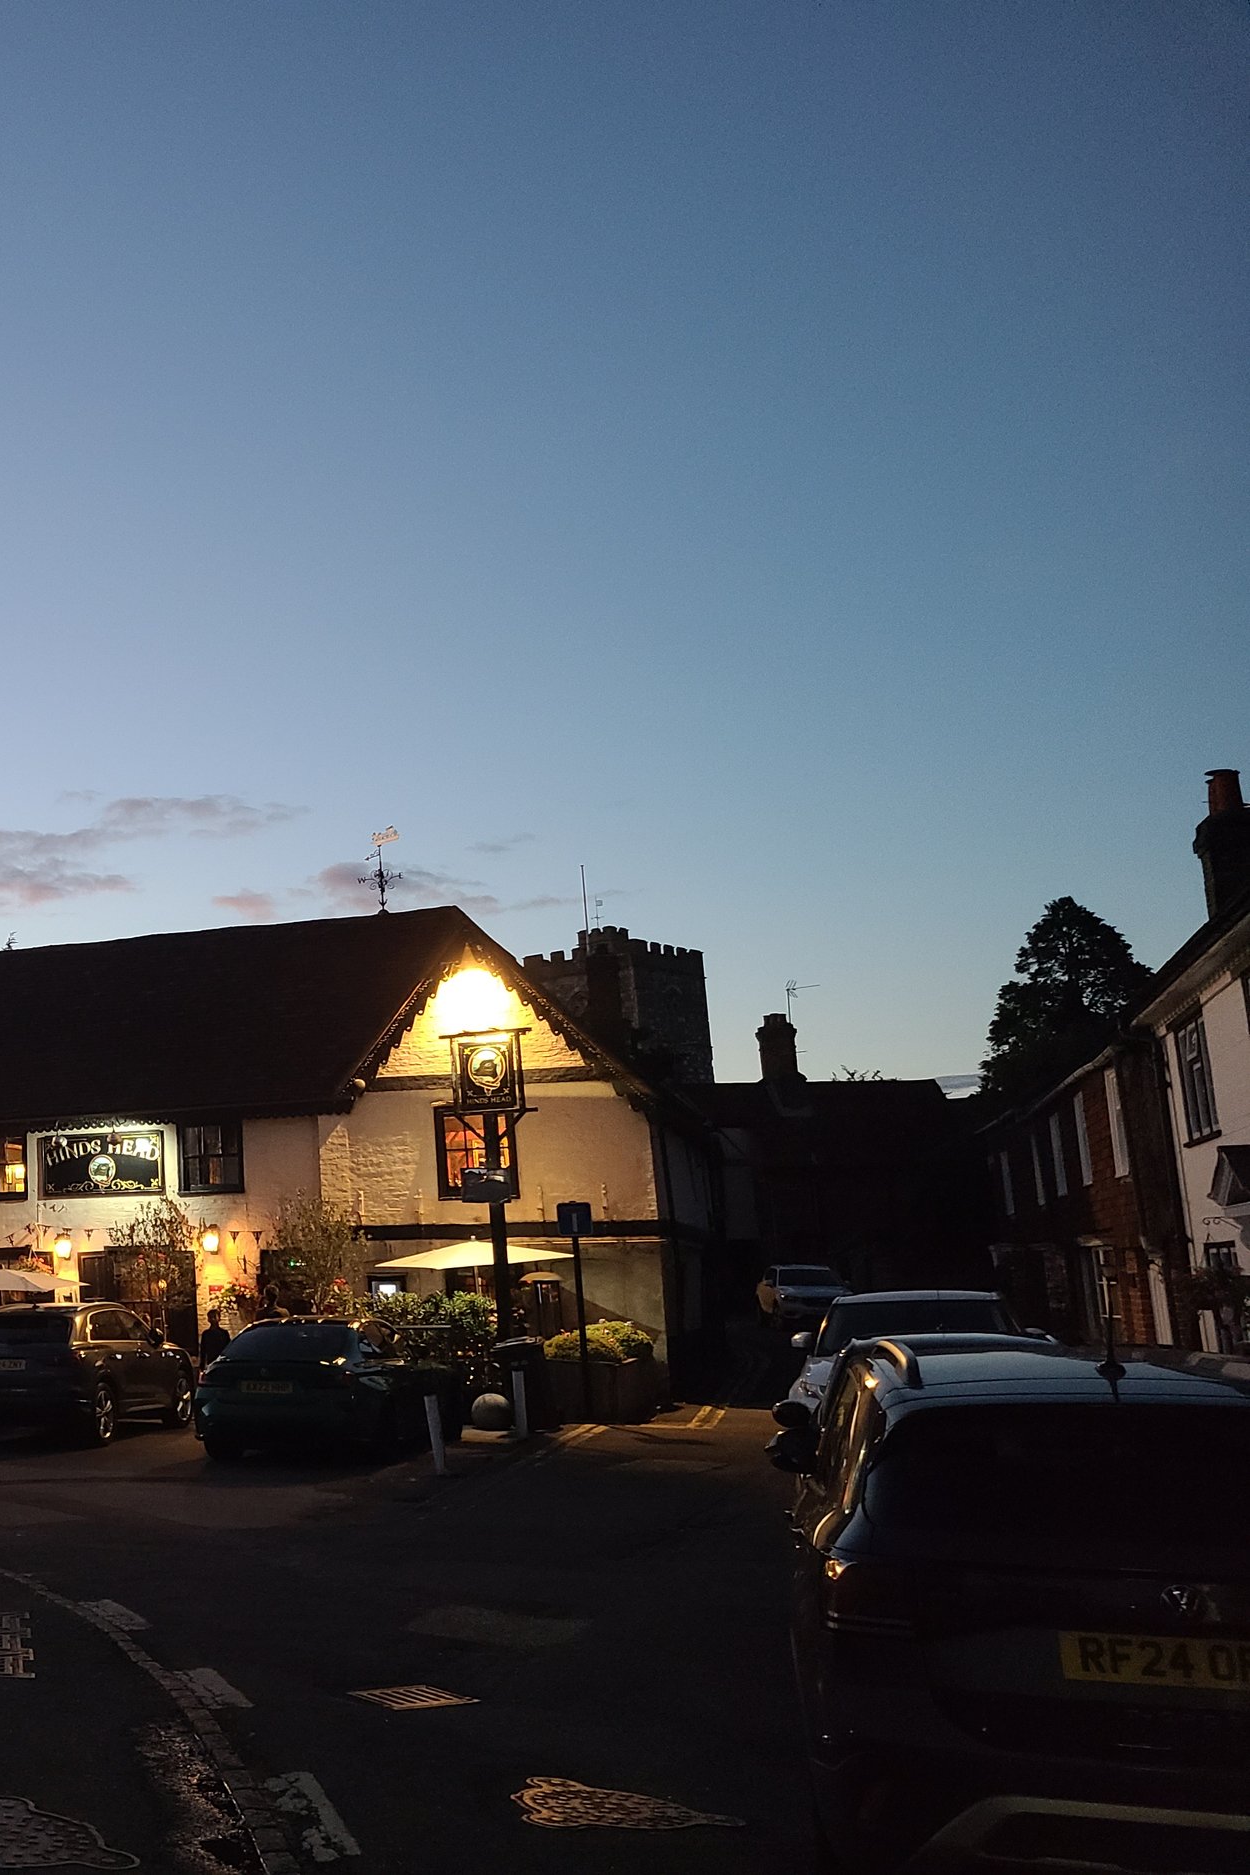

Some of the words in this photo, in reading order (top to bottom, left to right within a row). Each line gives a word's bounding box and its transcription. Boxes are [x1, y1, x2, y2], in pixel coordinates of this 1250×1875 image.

[467, 1097, 489, 1105] HINDS
[490, 1096, 512, 1104] HEAD
[46, 1139, 102, 1167] HINDS
[107, 1138, 160, 1161] HEAD
[1078, 1636, 1194, 1679] RF24
